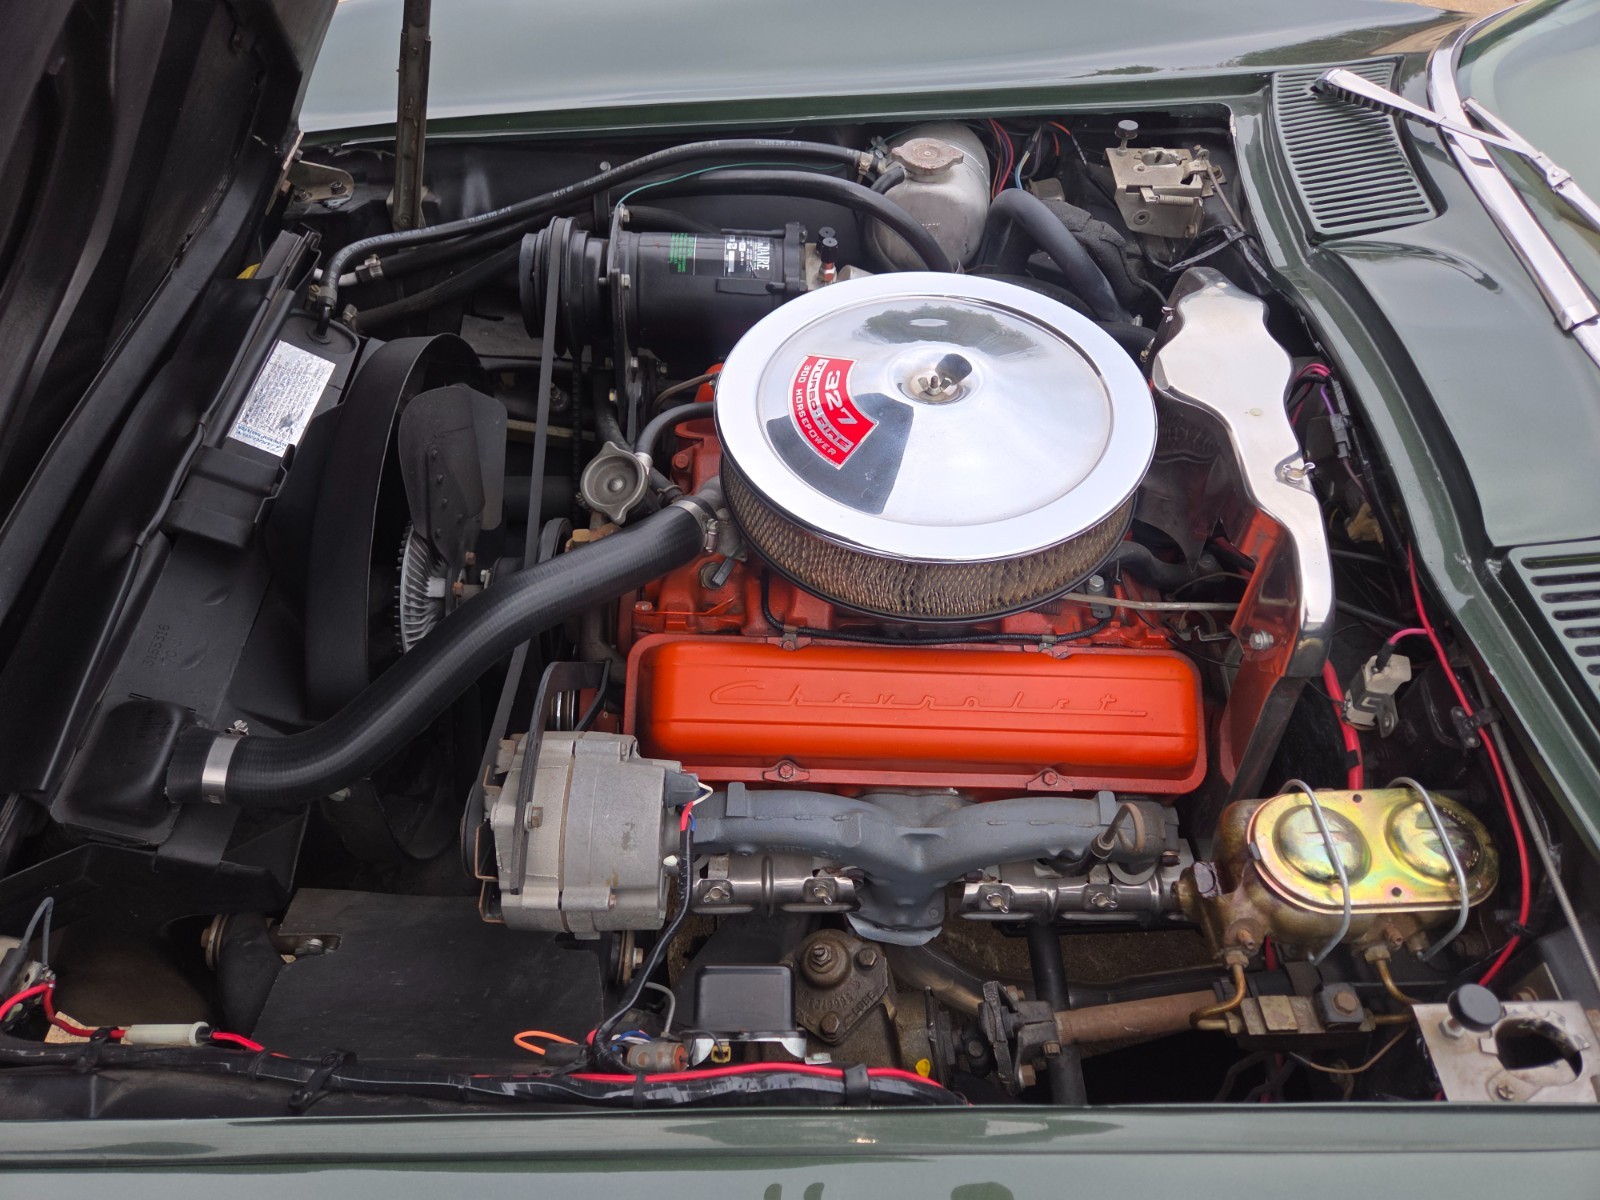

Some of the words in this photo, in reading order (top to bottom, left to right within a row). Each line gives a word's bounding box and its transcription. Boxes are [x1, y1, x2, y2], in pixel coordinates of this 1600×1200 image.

[798, 364, 812, 383] 300
[824, 370, 858, 425] 327
[795, 388, 837, 456] HORSEPOWER
[709, 680, 1148, 717] Chevrolet
